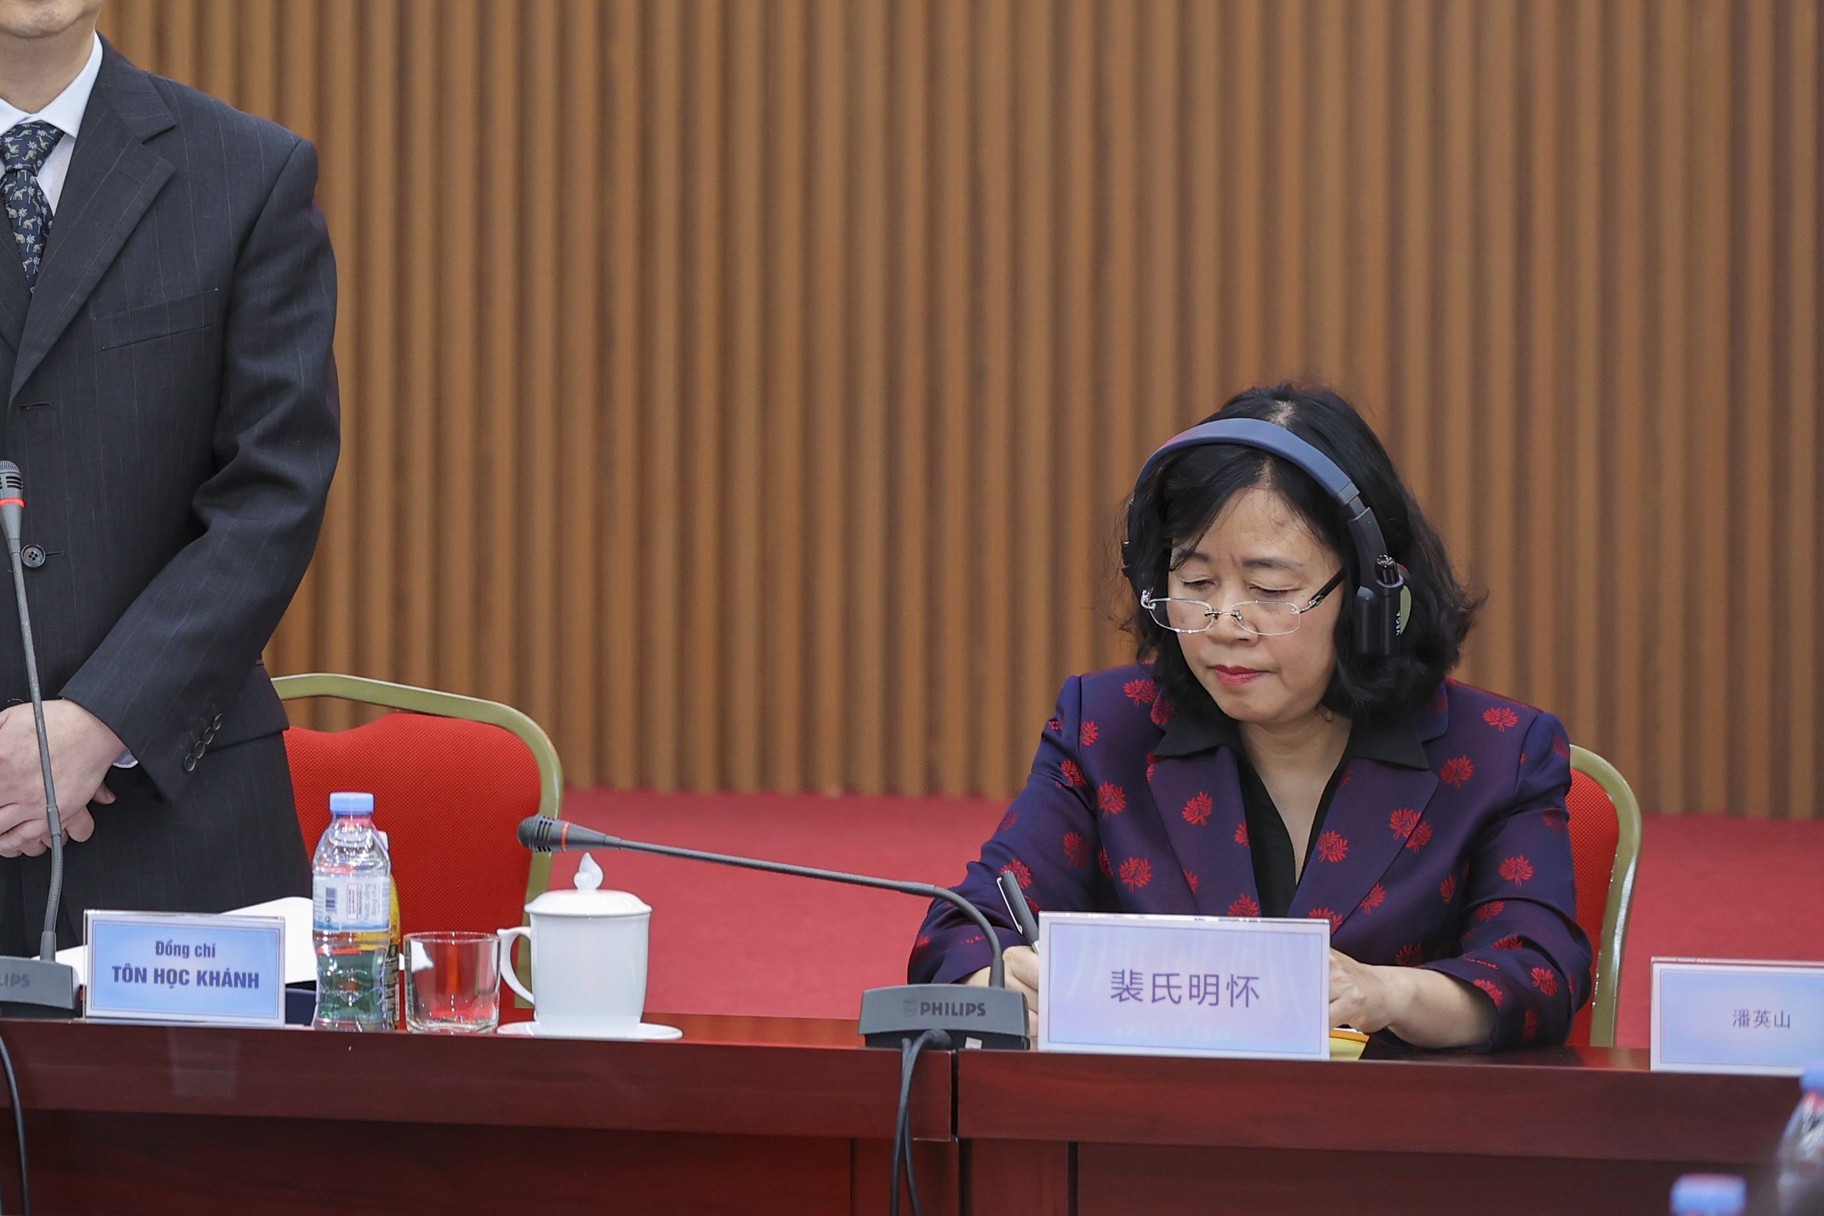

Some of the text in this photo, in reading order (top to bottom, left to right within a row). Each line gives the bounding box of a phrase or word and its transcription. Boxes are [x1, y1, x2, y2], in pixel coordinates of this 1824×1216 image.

[194, 942, 216, 958] chí
[112, 962, 259, 989] TÔN HỌC KHÁNH
[1110, 968, 1260, 1008] 裴氏明怀
[920, 1001, 986, 1017] PHILIPS
[1732, 1008, 1792, 1030] 潘英山
